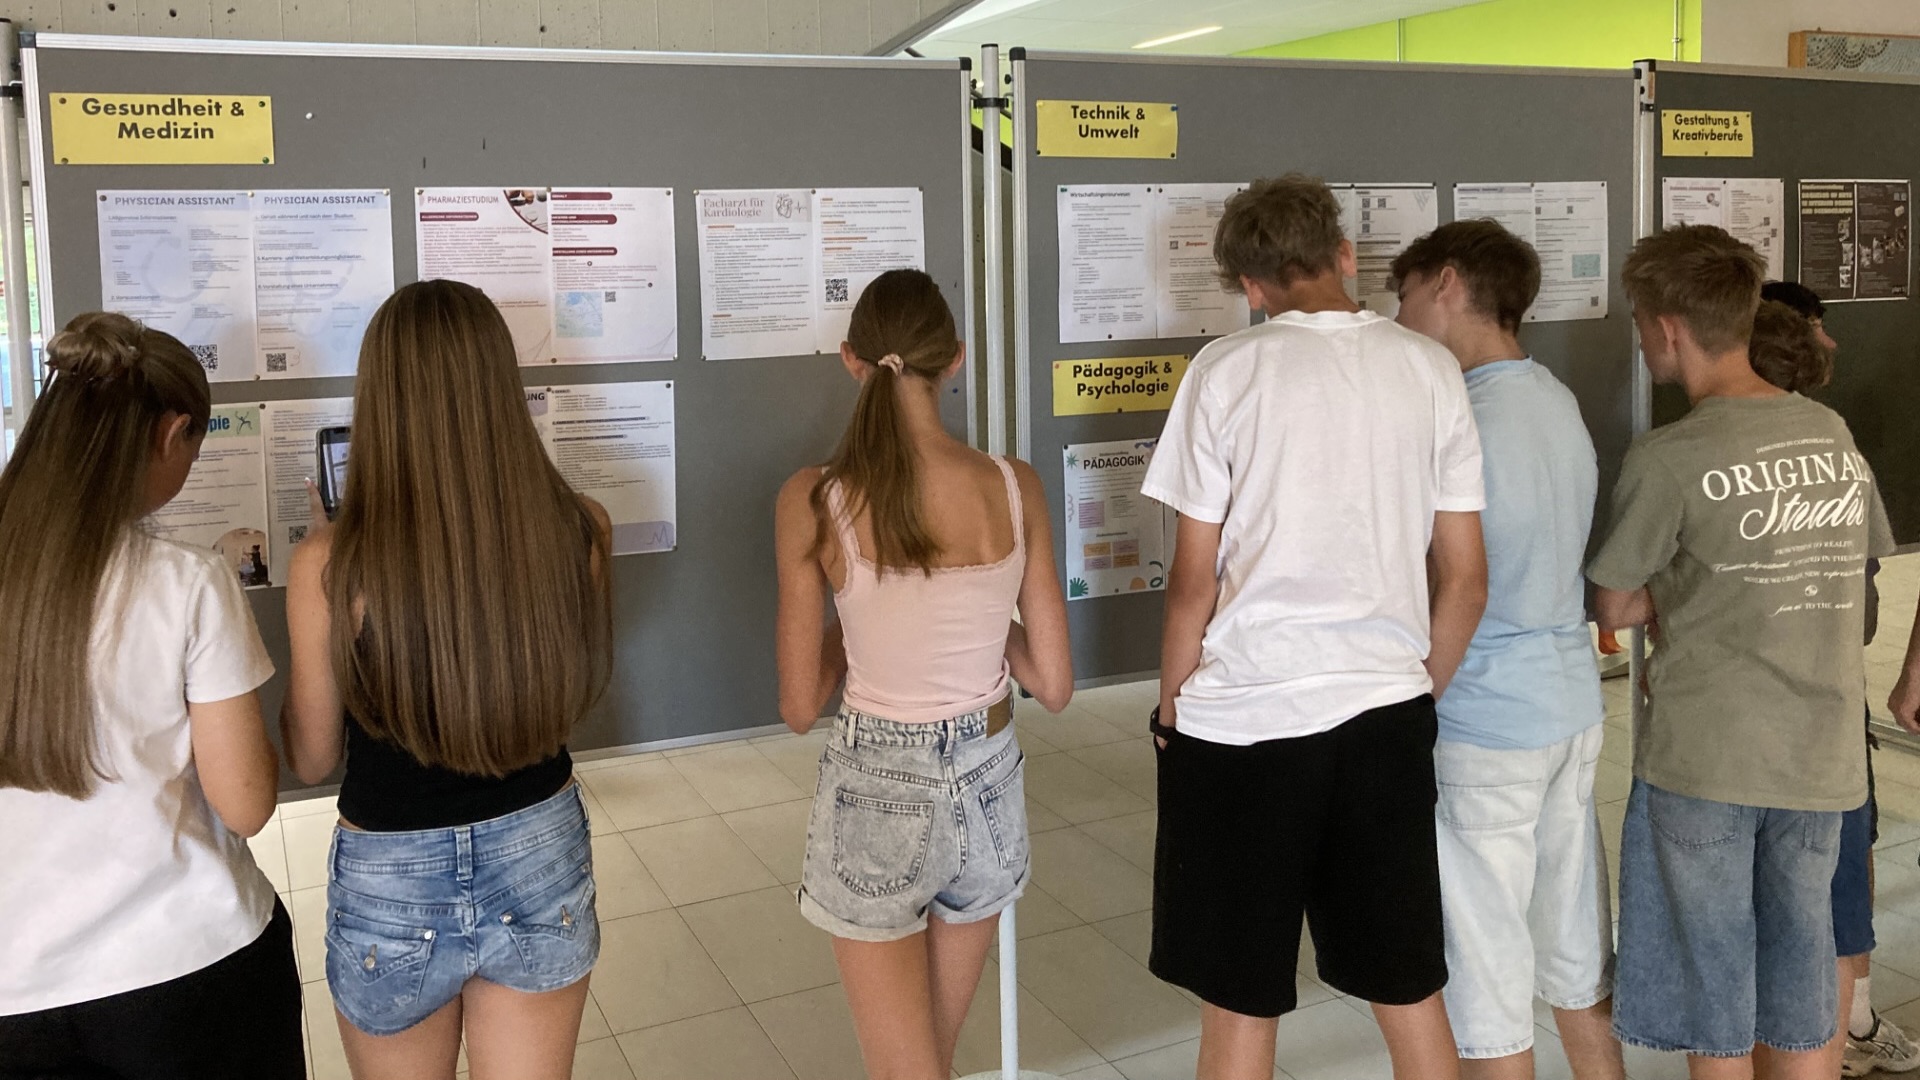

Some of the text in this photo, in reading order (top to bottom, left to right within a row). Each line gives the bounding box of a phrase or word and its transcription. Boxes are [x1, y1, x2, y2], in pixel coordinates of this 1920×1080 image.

[82, 97, 245, 116] Gesundheit &
[1071, 104, 1145, 120] Technik &
[1674, 113, 1739, 129] Gestaltung &
[118, 121, 214, 139] Medizin
[1078, 124, 1140, 138] Umwelt
[1672, 129, 1744, 141] Kreativberufe
[115, 196, 236, 206] PHYSICIAN ASSISTANT
[264, 195, 376, 205] PHYSICIAN ASSISTANT
[427, 195, 499, 204] PHARMAZIESTUDIUM
[704, 197, 765, 208] Facharzt für
[704, 207, 762, 218] Kardiologie
[1073, 360, 1173, 380] Pädagogik &
[1077, 378, 1169, 399] Psychologie
[208, 415, 231, 433] pie
[1083, 454, 1145, 470] PÄDAGOGIK
